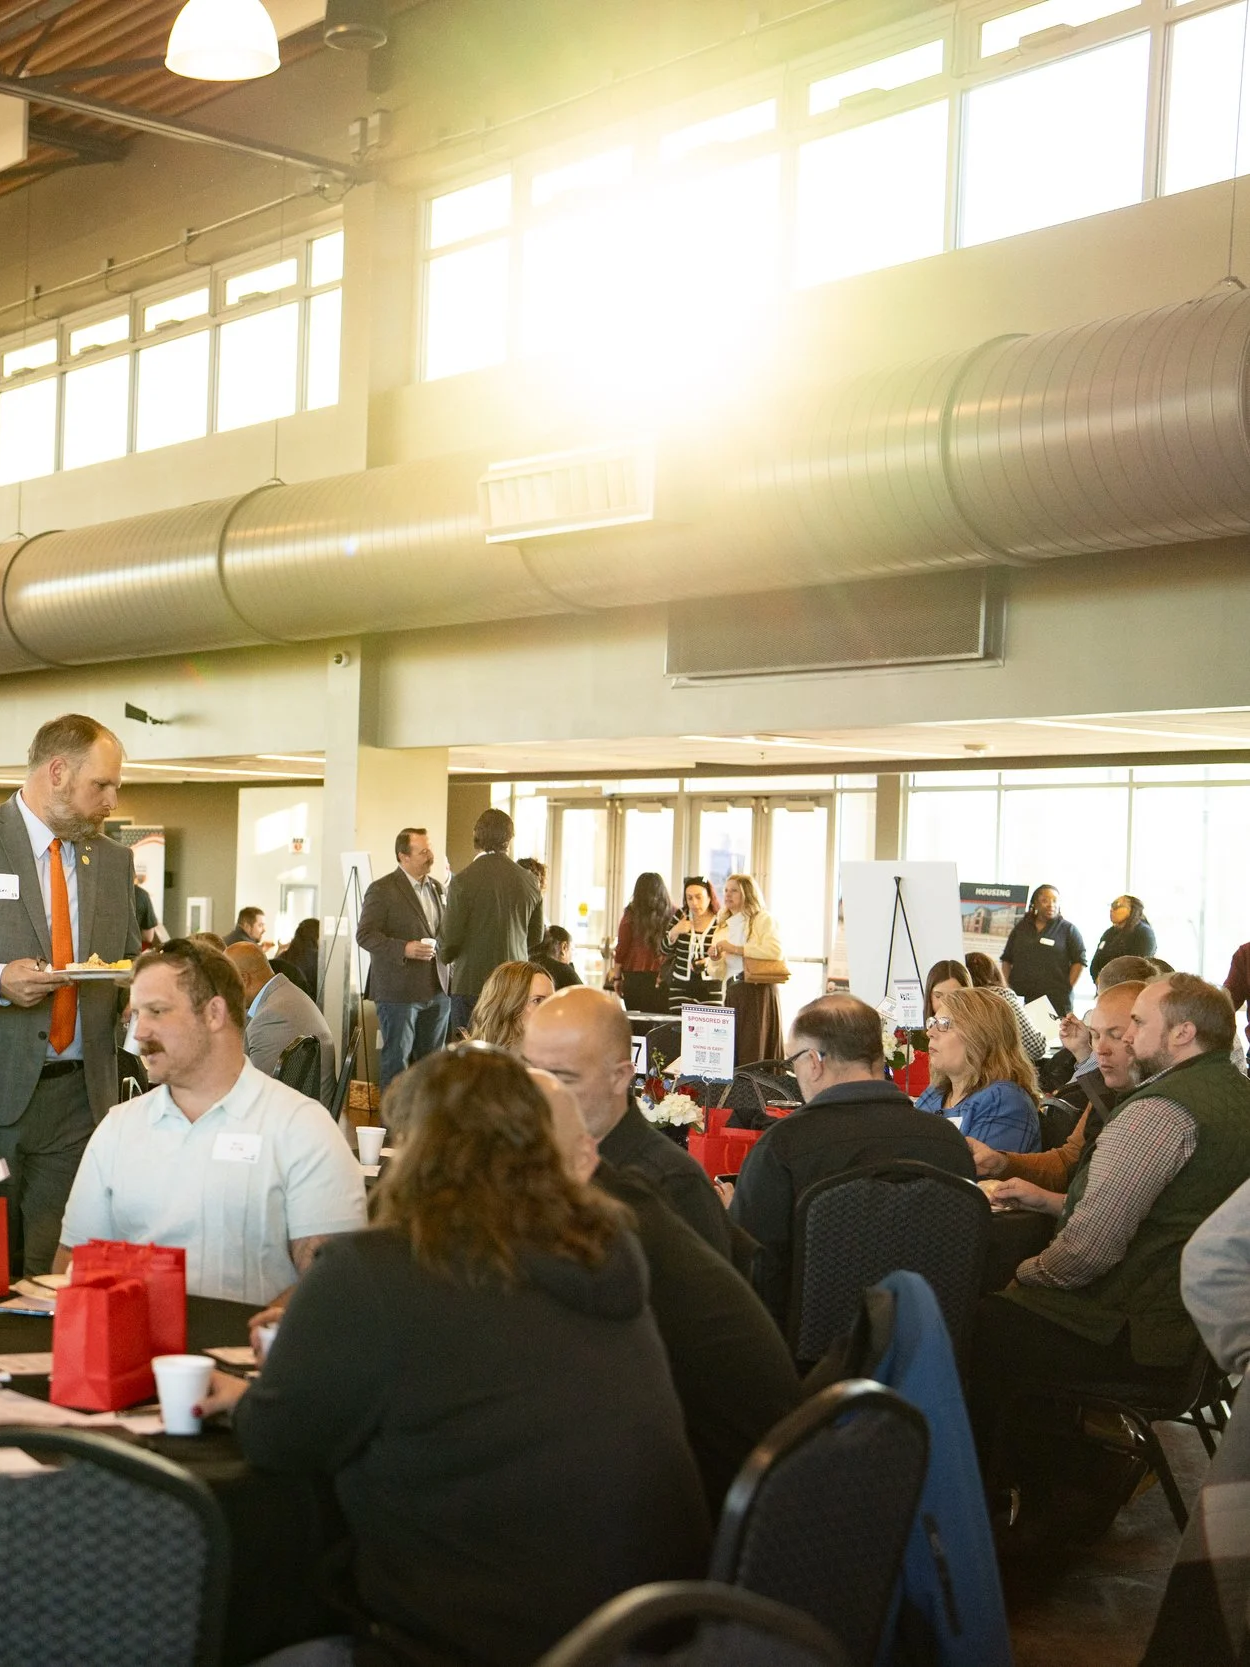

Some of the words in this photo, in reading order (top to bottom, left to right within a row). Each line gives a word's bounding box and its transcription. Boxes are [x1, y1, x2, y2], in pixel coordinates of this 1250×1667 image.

[975, 887, 1011, 897] HOUSING
[688, 1016, 721, 1024] SPONSORED
[631, 1042, 642, 1067] 7
